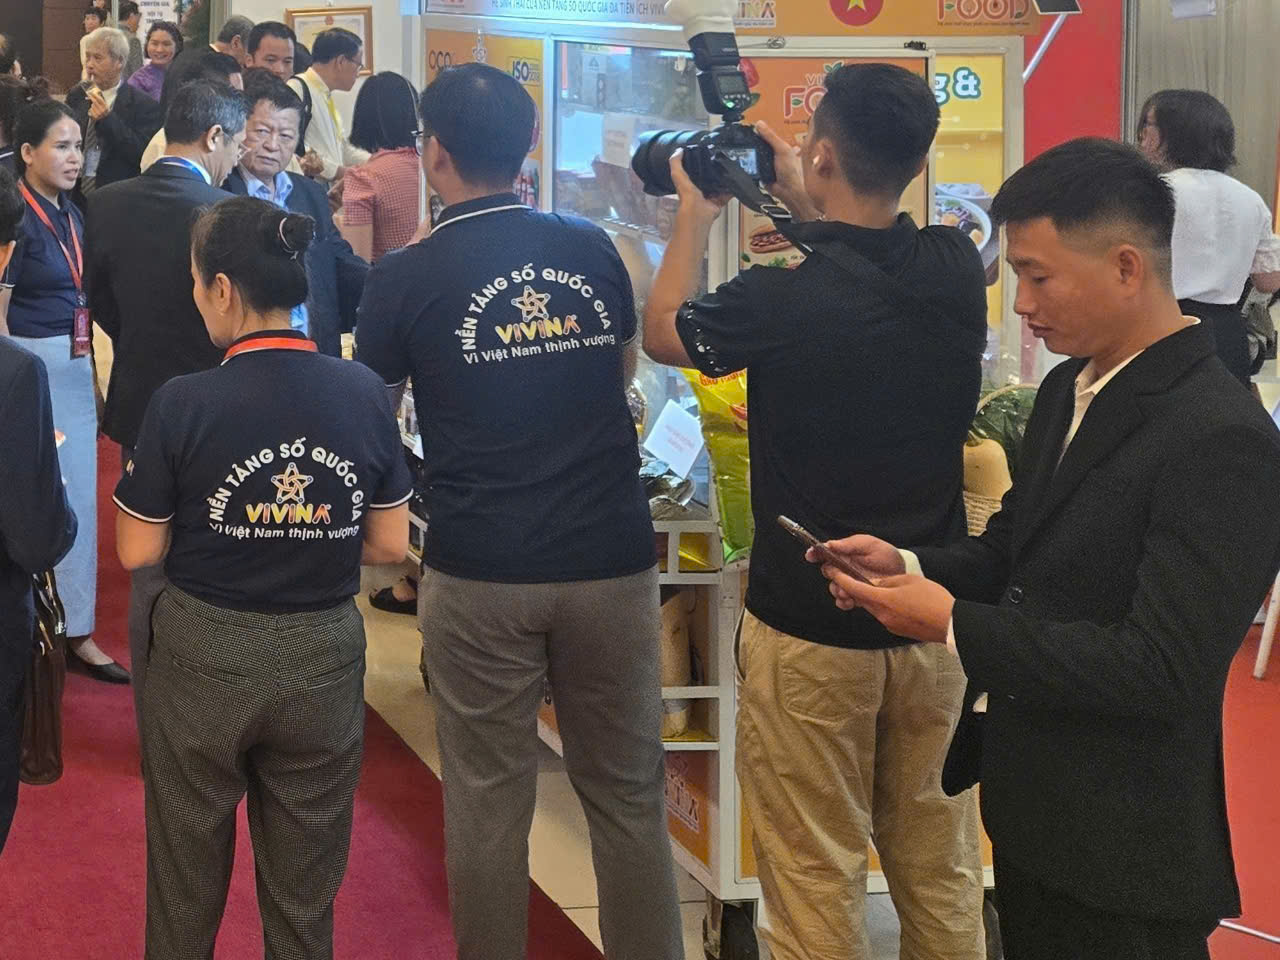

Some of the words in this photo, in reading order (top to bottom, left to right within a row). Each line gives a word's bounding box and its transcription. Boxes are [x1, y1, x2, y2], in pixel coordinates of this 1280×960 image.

[597, 1, 608, 13] GIA
[609, 1, 619, 14] ĐA
[636, 0, 648, 15] ÍCH
[650, 2, 665, 15] VIVI
[512, 61, 529, 81] ISO
[933, 74, 950, 106] g
[954, 67, 981, 100] &
[784, 86, 828, 119] FO
[454, 317, 478, 350] NỀN
[468, 277, 508, 314] TẢNG
[511, 263, 536, 284] SỐ
[542, 268, 593, 298] QUỐC
[593, 299, 612, 330] GIA
[495, 314, 581, 344] VIVINA
[481, 346, 508, 363] Việt
[511, 345, 542, 358] Nam
[545, 337, 580, 353] thịnh
[583, 334, 616, 347] vượng
[225, 448, 274, 488] TẢNG
[280, 436, 307, 459] SỐ
[312, 447, 358, 488] QUỐC
[351, 490, 364, 522] GIA
[246, 502, 332, 525] VIVINA
[224, 525, 251, 540] Việt
[254, 527, 284, 539] Nam
[288, 527, 323, 541] thịnh
[328, 525, 360, 540] vượng
